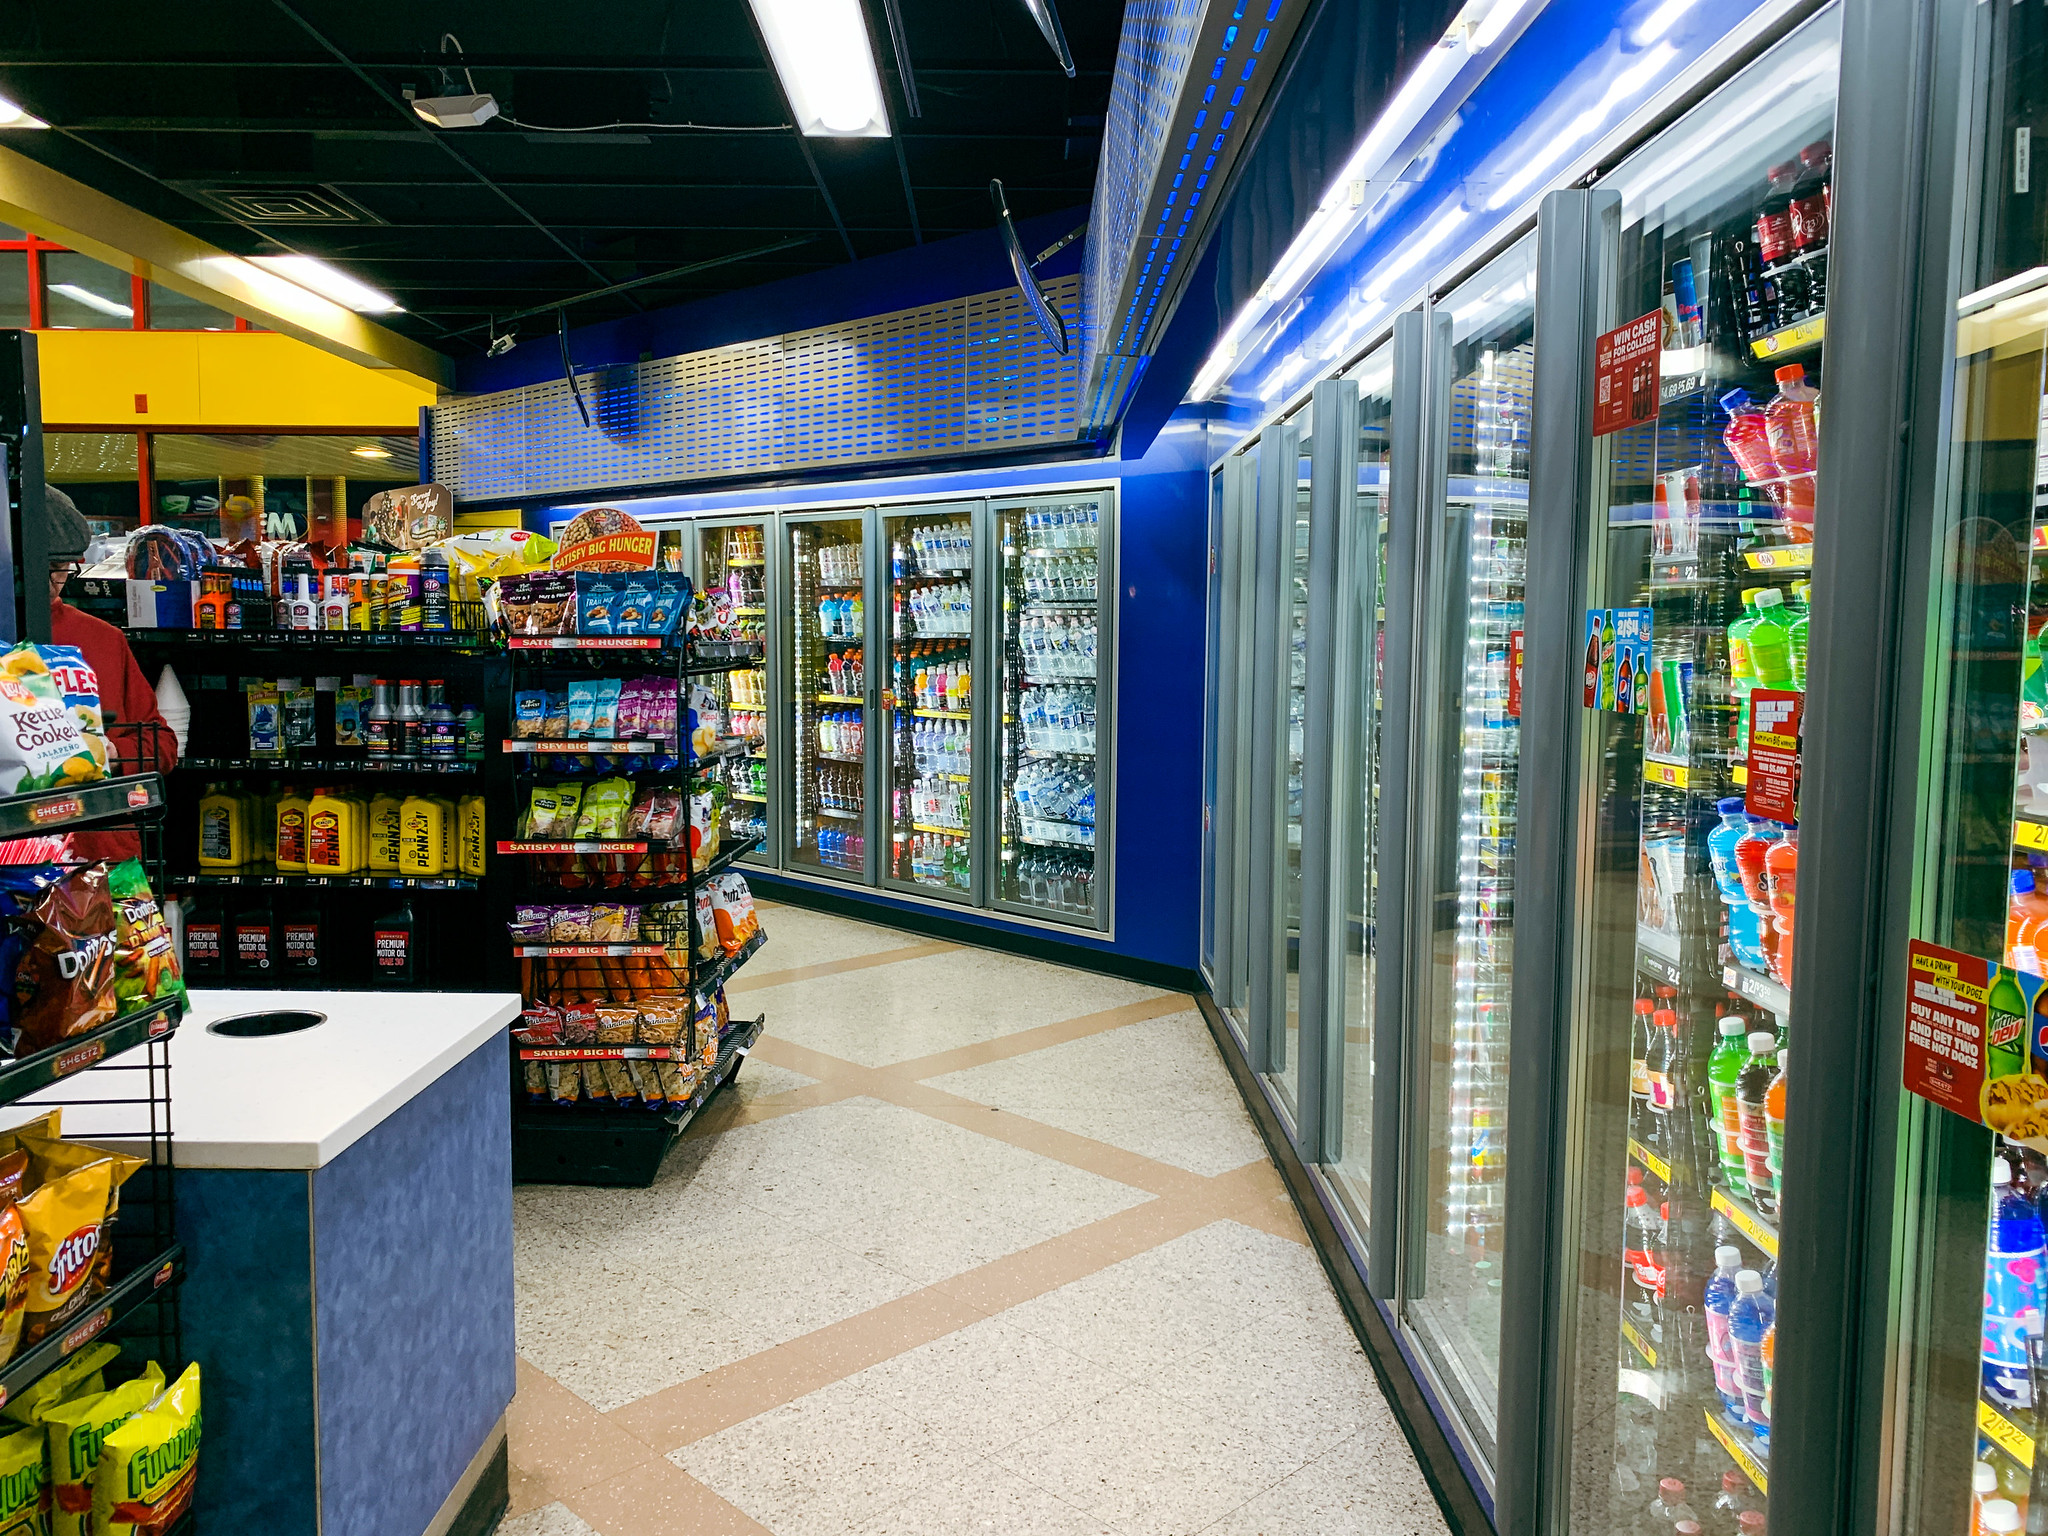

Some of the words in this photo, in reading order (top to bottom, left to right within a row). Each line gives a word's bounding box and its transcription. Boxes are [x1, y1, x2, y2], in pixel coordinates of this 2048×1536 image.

[1613, 328, 1631, 347] WIN
[1632, 316, 1657, 338] CASH
[1613, 345, 1626, 359] FOR
[1626, 331, 1656, 351] COLLEGE
[1678, 376, 1696, 394] $5.69
[554, 549, 587, 571] SATISFY
[588, 542, 606, 556] BIG
[609, 536, 654, 556] HUNGER
[425, 581, 438, 590] STP
[202, 606, 215, 614] STP
[585, 597, 602, 607] TRAIL
[295, 607, 308, 615] STP
[1617, 618, 1639, 637] 2/$4
[522, 639, 553, 647] SATIS
[598, 639, 648, 647] HUNGER
[52, 668, 98, 695] FLES
[9, 707, 65, 733] Kettle
[15, 720, 80, 751] Cooked
[37, 743, 80, 760] JALAPEÑO
[37, 802, 76, 818] SHEETZ
[124, 900, 159, 924] Doritos
[189, 932, 217, 941] PREMIUM
[238, 934, 266, 943] PREMIUM
[286, 932, 315, 941] PREMIUM
[377, 939, 405, 949] PREMIUM
[189, 941, 207, 950] MOTOR
[208, 942, 219, 950] OIL
[238, 943, 257, 951] MOTOR
[257, 943, 268, 951] OIL
[286, 941, 305, 950] MOTOR
[306, 942, 316, 950] OIL
[376, 949, 396, 957] MOTOR
[396, 949, 406, 958] OIL
[57, 929, 117, 980] Doritos
[379, 957, 394, 966] SAE
[1915, 956, 1929, 968] HAVE
[1934, 961, 1953, 973] DRINK
[1935, 974, 1949, 987] WITH
[1950, 978, 1965, 992] YOUR
[1966, 985, 1983, 1000] DOGZ
[1911, 1001, 1932, 1019] BUY
[1933, 1010, 1955, 1028] ANY
[1955, 1018, 1980, 1038] TWO
[1910, 1019, 1932, 1038] AND
[1933, 1029, 1953, 1047] GET
[1954, 1037, 1979, 1057] TWO
[60, 1044, 99, 1069] SHEETZ
[533, 1049, 581, 1057] SATISFY
[583, 1049, 604, 1057] BIG
[1909, 1031, 1931, 1049] FREE
[1931, 1041, 1950, 1057] HOT
[1951, 1048, 1978, 1069] DOGZ
[48, 1224, 102, 1295] Fritos
[68, 1315, 105, 1347] SHEETZ
